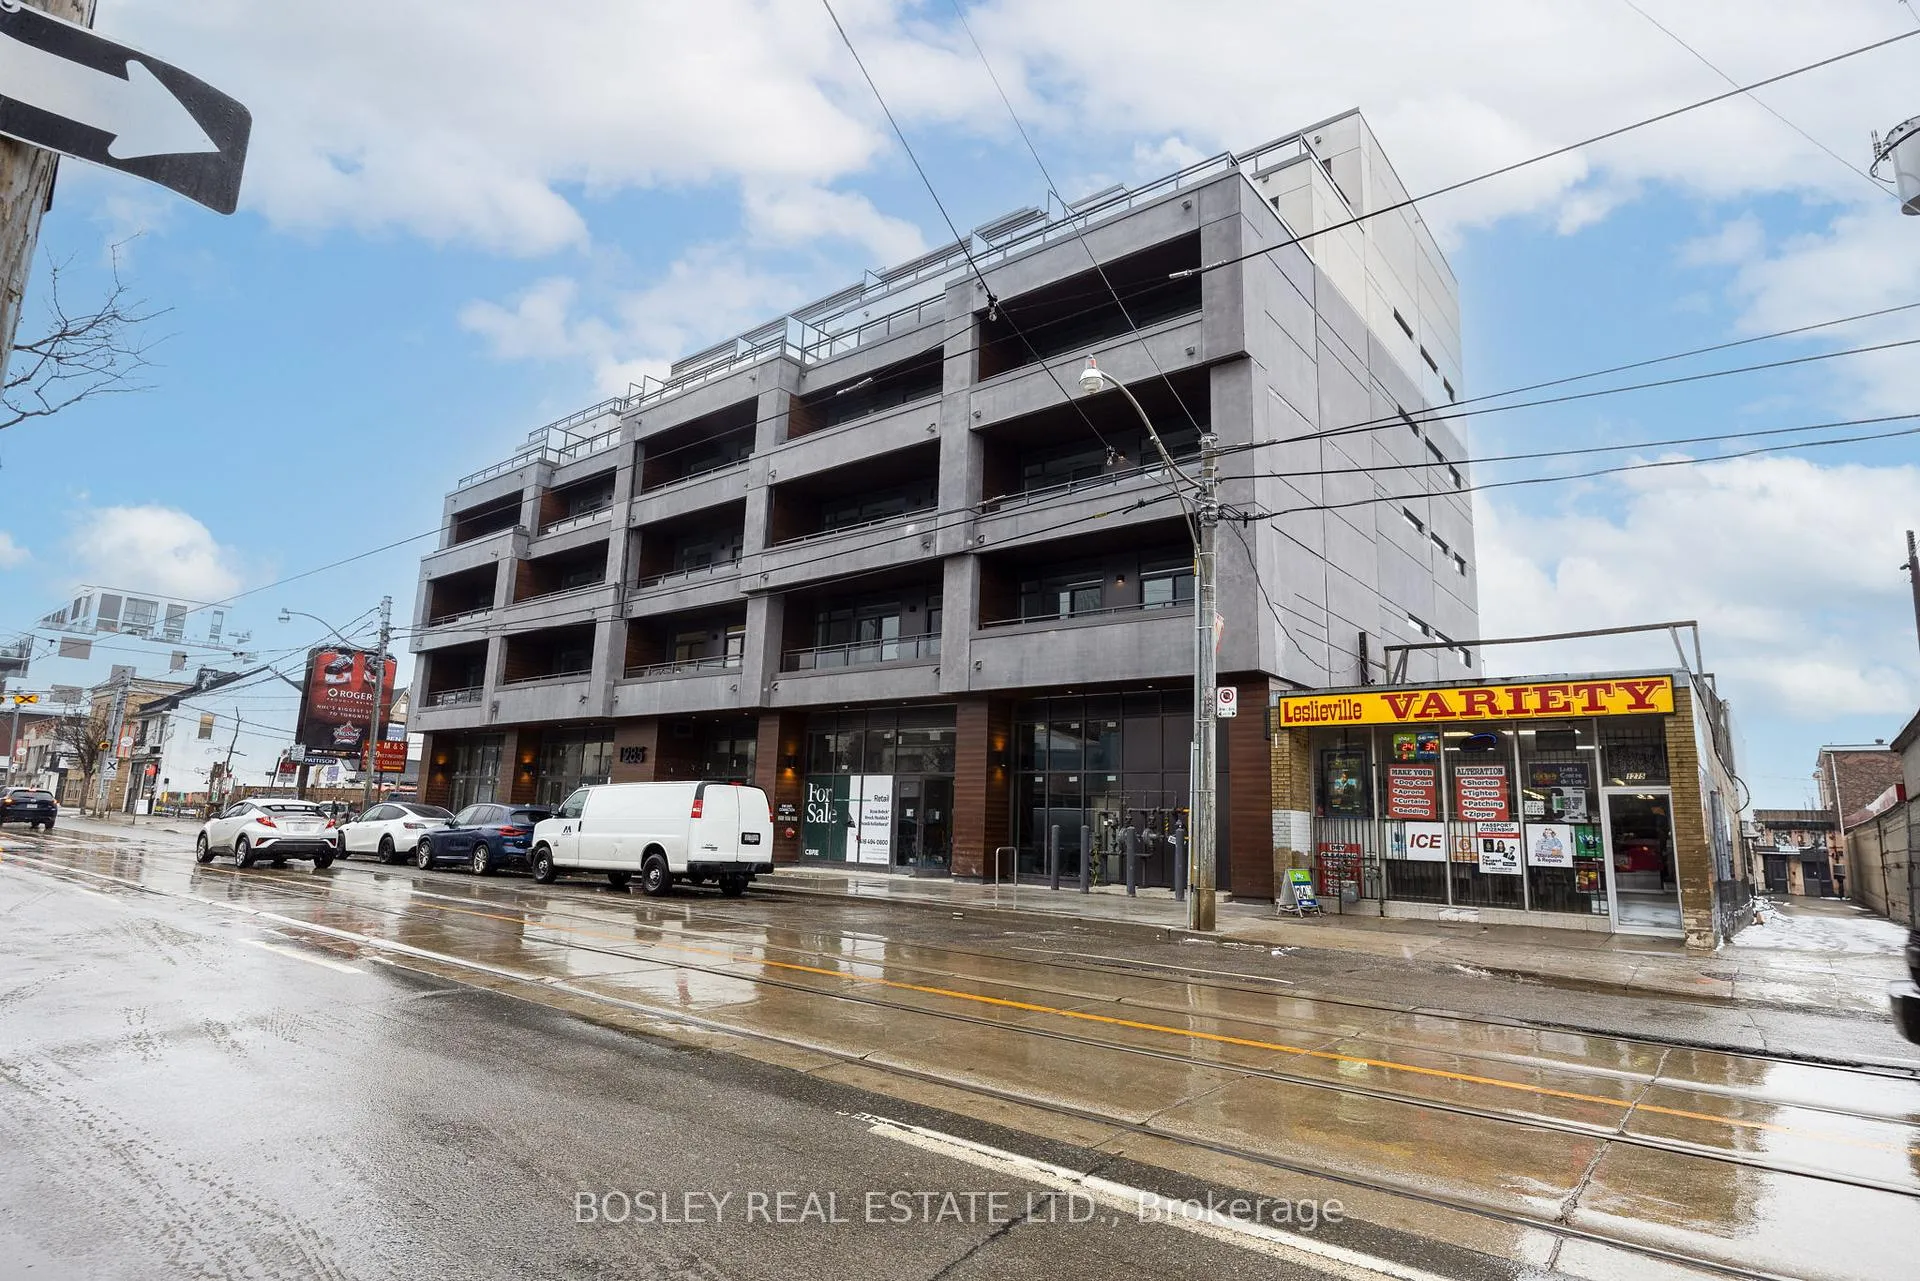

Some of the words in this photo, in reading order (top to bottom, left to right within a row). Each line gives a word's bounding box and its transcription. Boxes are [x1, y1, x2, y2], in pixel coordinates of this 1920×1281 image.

[339, 690, 376, 701] ROGER
[1283, 698, 1362, 723] Leslieville
[1381, 680, 1666, 720] VARIETY
[338, 706, 364, 714] BIGGEST
[340, 712, 370, 720] TORONTO
[304, 757, 336, 765] PATTISON
[1456, 767, 1504, 776] ALTERATION
[1399, 779, 1414, 787] Dog
[807, 782, 834, 803] For
[1398, 789, 1425, 797] Aprons
[1467, 789, 1498, 797] Tighten
[873, 794, 889, 804] Retail
[1468, 799, 1504, 808] Patching
[806, 802, 838, 824] Sale
[1398, 807, 1429, 815] Bedding
[1468, 810, 1495, 818] Zipper
[1409, 833, 1442, 849] ICE
[804, 848, 819, 856] CBRE
